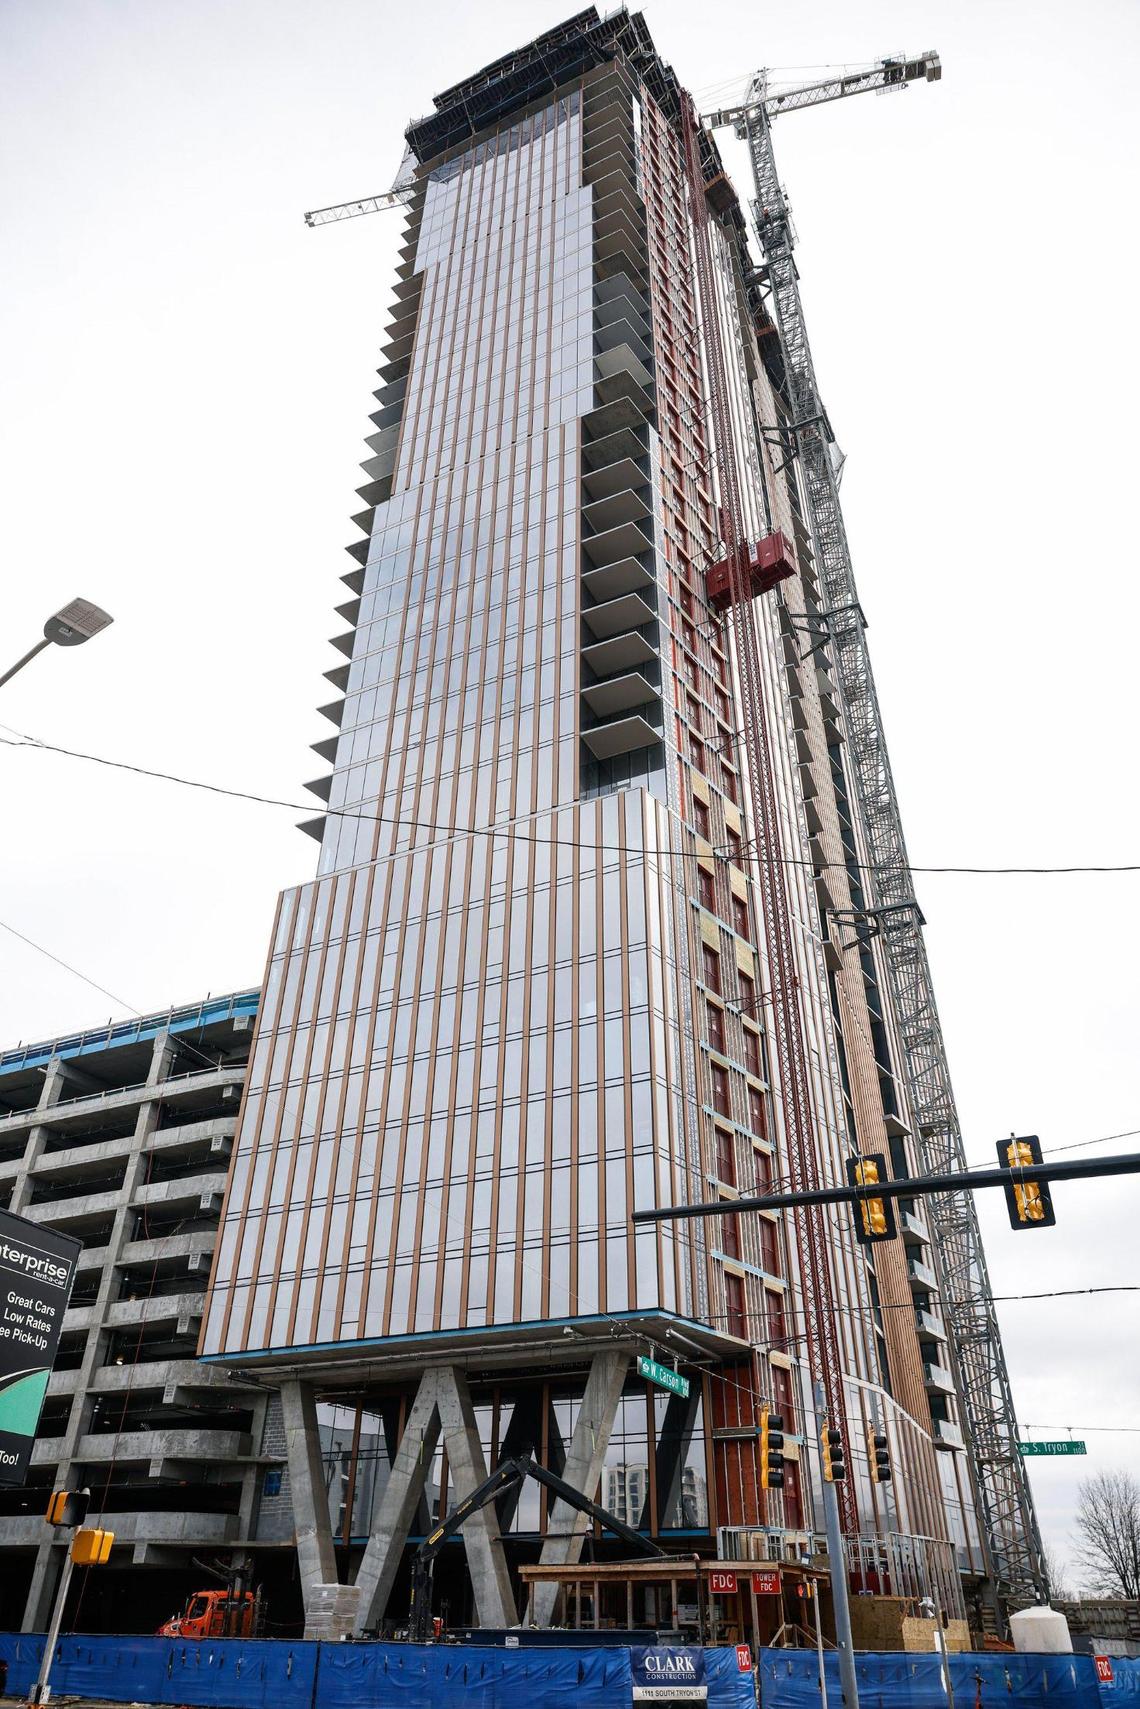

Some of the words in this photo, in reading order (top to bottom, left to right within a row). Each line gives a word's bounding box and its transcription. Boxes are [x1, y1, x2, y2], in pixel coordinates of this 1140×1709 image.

[0, 1244, 67, 1280] terprise
[33, 1271, 65, 1286] rent-a-car
[7, 1291, 33, 1309] Great
[35, 1300, 56, 1316] Cars
[3, 1307, 25, 1324] Low
[25, 1314, 52, 1333] Rates
[12, 1327, 48, 1351] Pick-Up
[650, 1363, 657, 1378] W.
[659, 1368, 679, 1388] Carson
[1032, 1442, 1041, 1453] S.
[1043, 1442, 1068, 1454] Tryon
[712, 1574, 733, 1588] FDC
[756, 1573, 776, 1581] TOWER
[760, 1583, 773, 1591] FDC
[644, 1656, 695, 1671] CLARK
[738, 1651, 750, 1666] FDC
[1097, 1661, 1110, 1676] FDC
